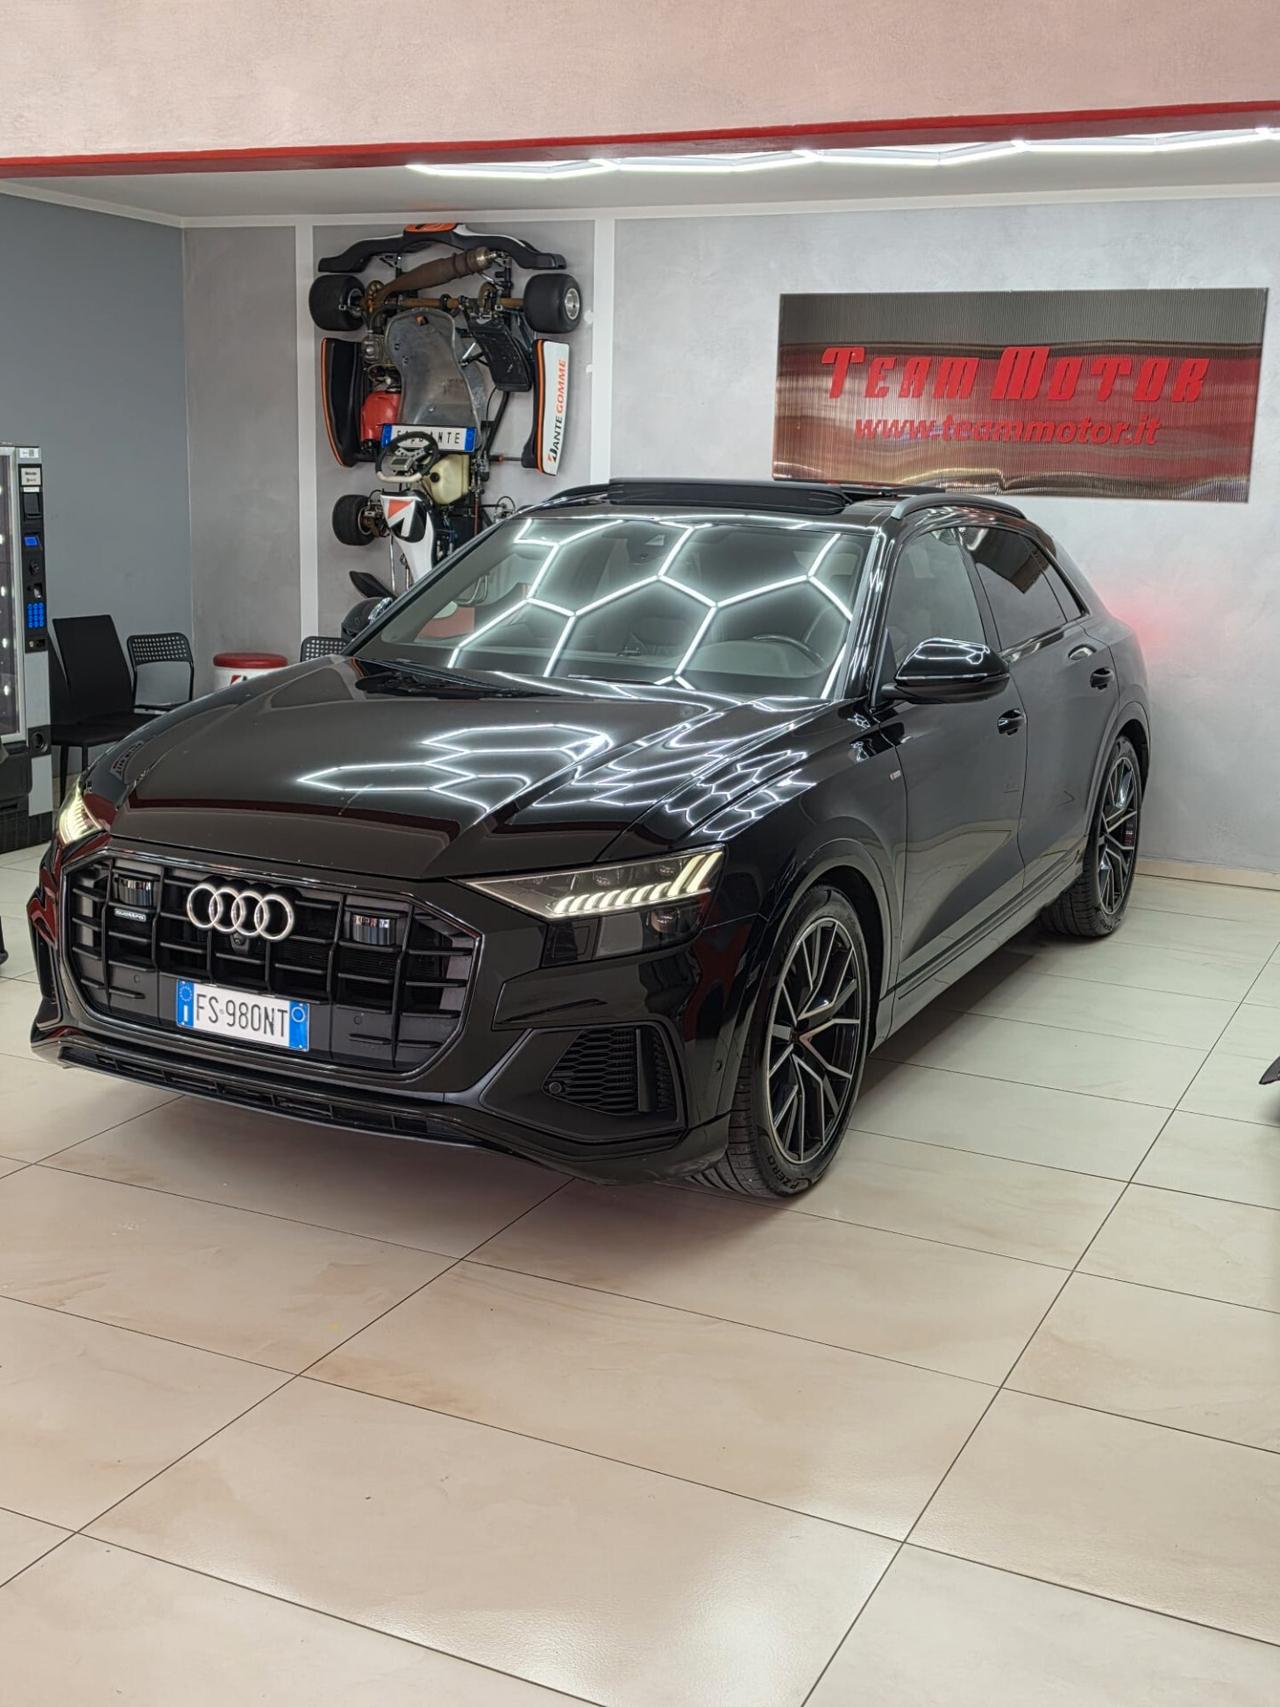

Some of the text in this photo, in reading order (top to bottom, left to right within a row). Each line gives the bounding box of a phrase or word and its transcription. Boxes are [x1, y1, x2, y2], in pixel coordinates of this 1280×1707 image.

[556, 360, 566, 414] GOMME
[821, 346, 1210, 401] TEAM MOTOR
[854, 415, 1160, 445] www.teammotor.it
